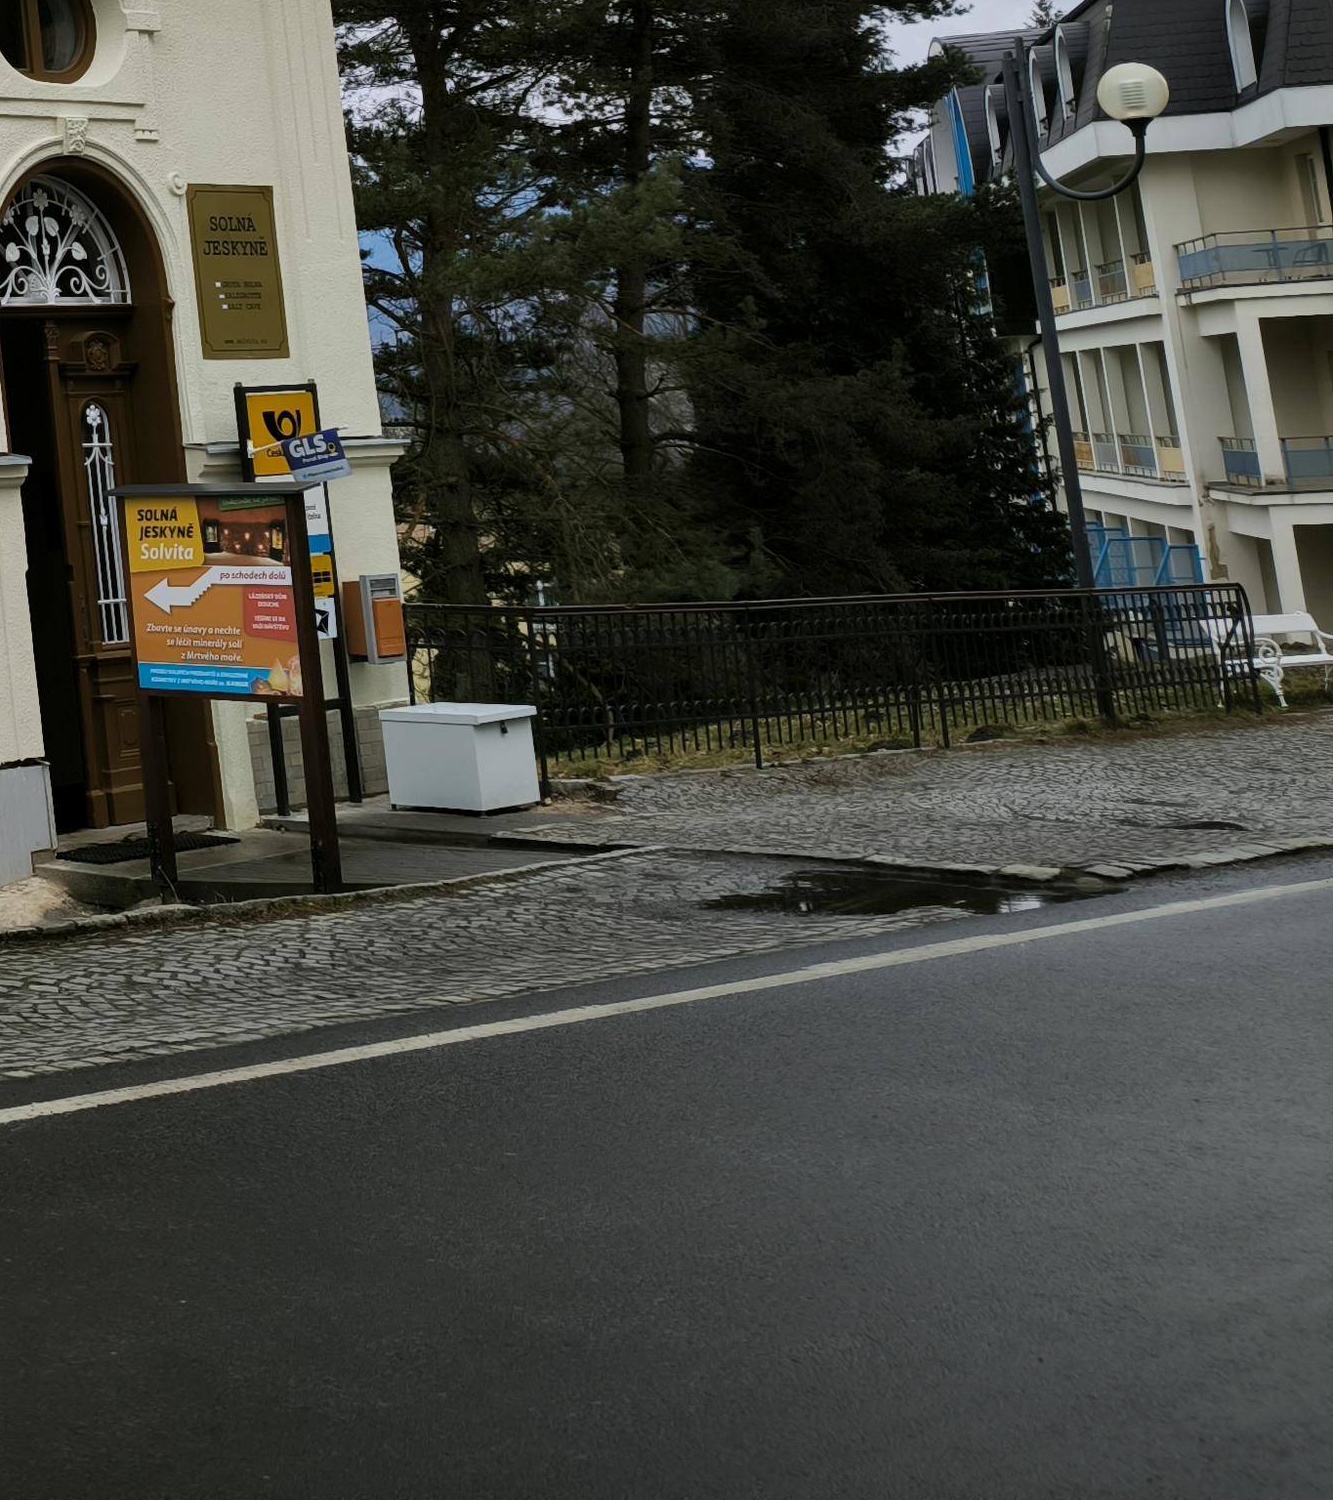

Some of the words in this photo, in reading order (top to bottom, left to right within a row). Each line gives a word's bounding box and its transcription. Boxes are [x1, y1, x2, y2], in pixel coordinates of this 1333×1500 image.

[209, 213, 256, 231] SOLNÁ
[203, 237, 268, 255] JESKYNĚ
[289, 434, 327, 458] GLS
[137, 506, 178, 522] SOLNÁ
[139, 523, 194, 541] JESKYNĚ
[140, 543, 194, 560] Solvita
[220, 572, 230, 580] po
[231, 571, 267, 579] schodech
[269, 571, 286, 580] dolů
[146, 623, 172, 633] Zbavte
[184, 624, 207, 635] únavy
[214, 625, 241, 635] nechte
[193, 638, 227, 650] minerály
[186, 651, 220, 661] Mrtvého
